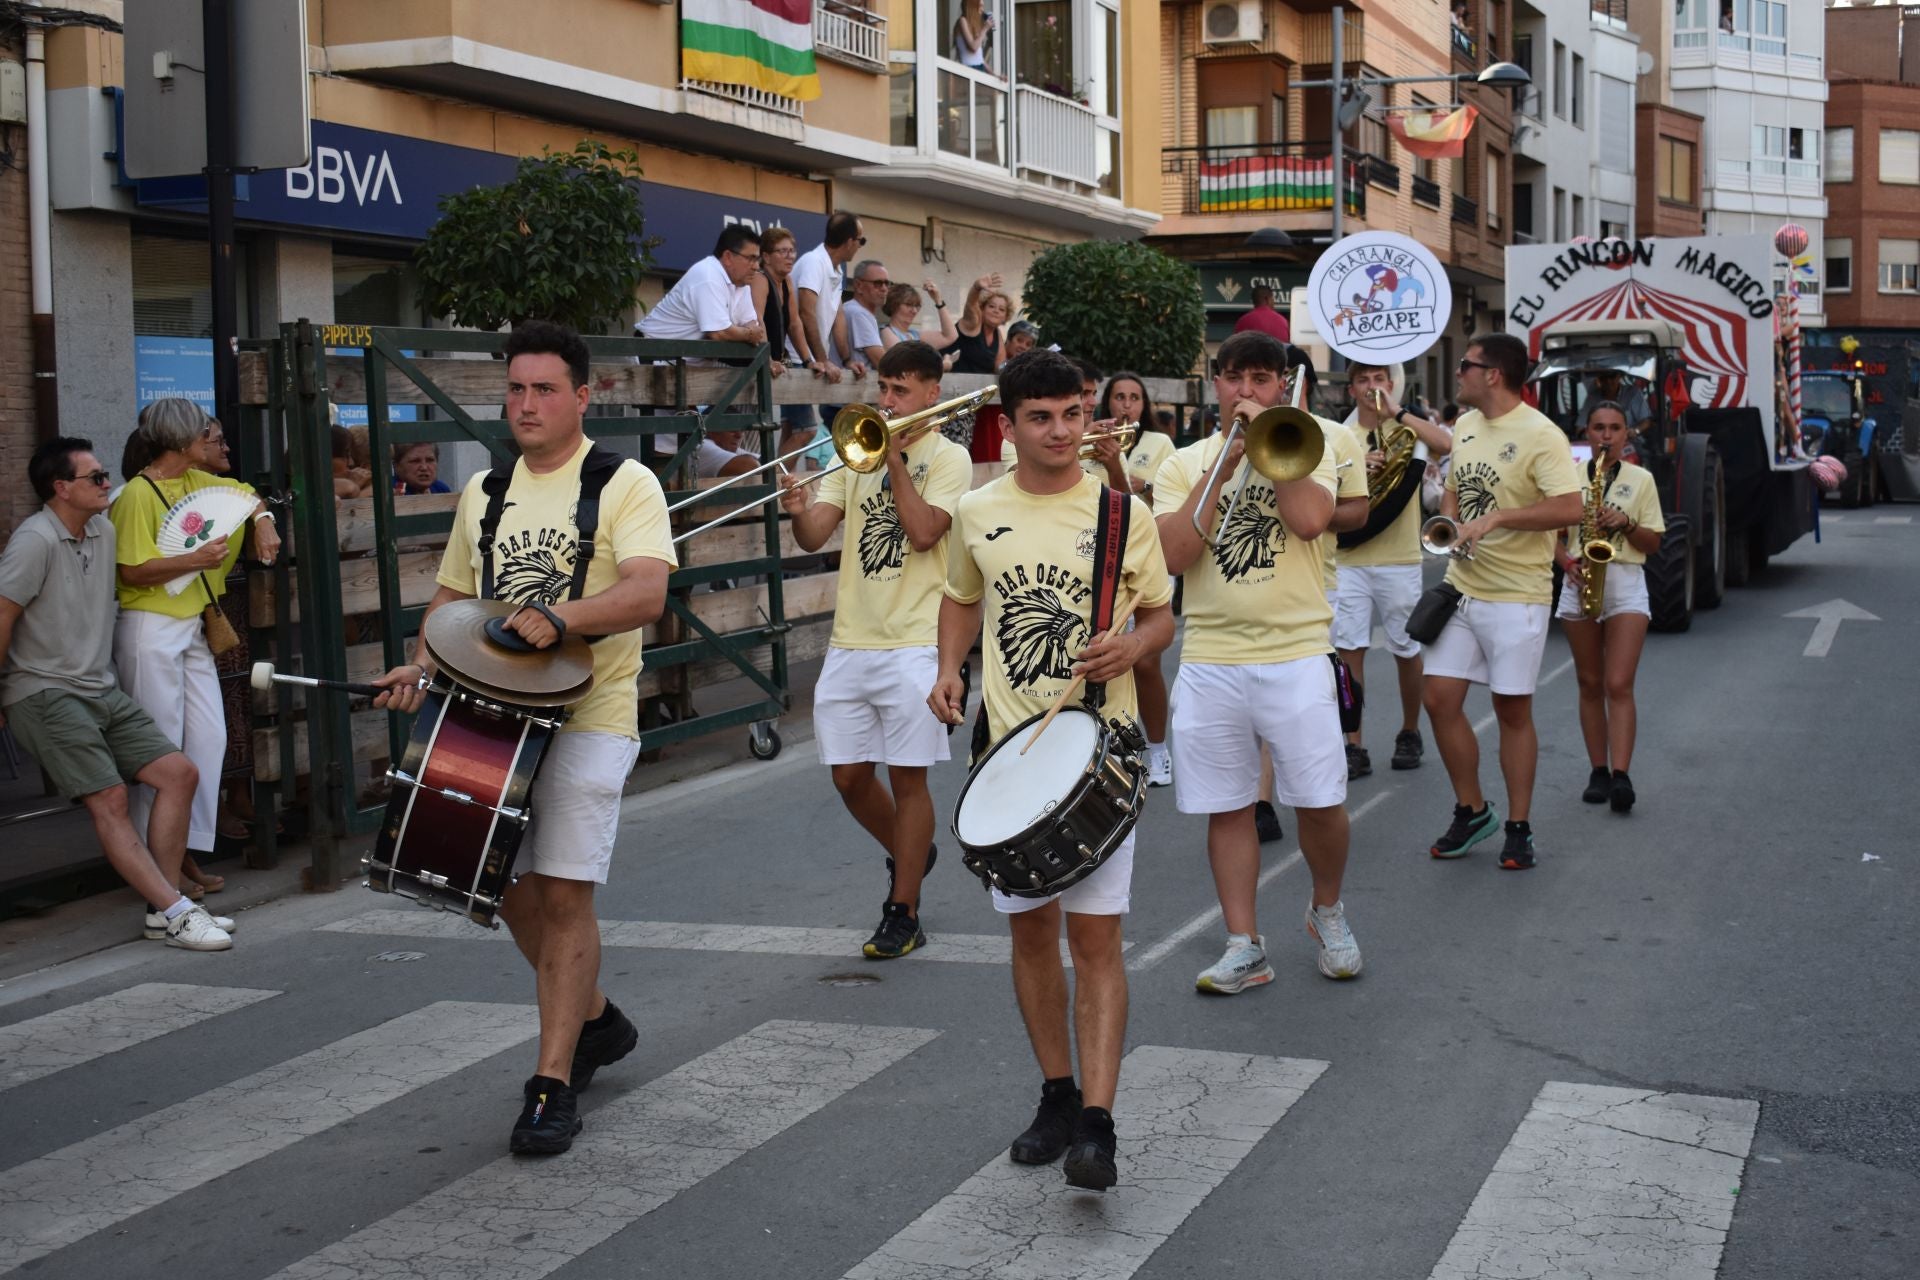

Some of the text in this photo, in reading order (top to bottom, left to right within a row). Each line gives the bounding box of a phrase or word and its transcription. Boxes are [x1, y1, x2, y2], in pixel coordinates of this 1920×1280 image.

[286, 146, 403, 206] BBVA
[1329, 247, 1416, 281] CHARANGA
[1509, 239, 1774, 328] EL RINCON MAGICO
[1347, 311, 1421, 337] ASCAPE
[141, 387, 153, 400] La
[860, 492, 885, 516] BAR
[497, 529, 532, 560] BAR
[1108, 518, 1119, 559] STRAP
[993, 562, 1092, 605] BAR OESTE
